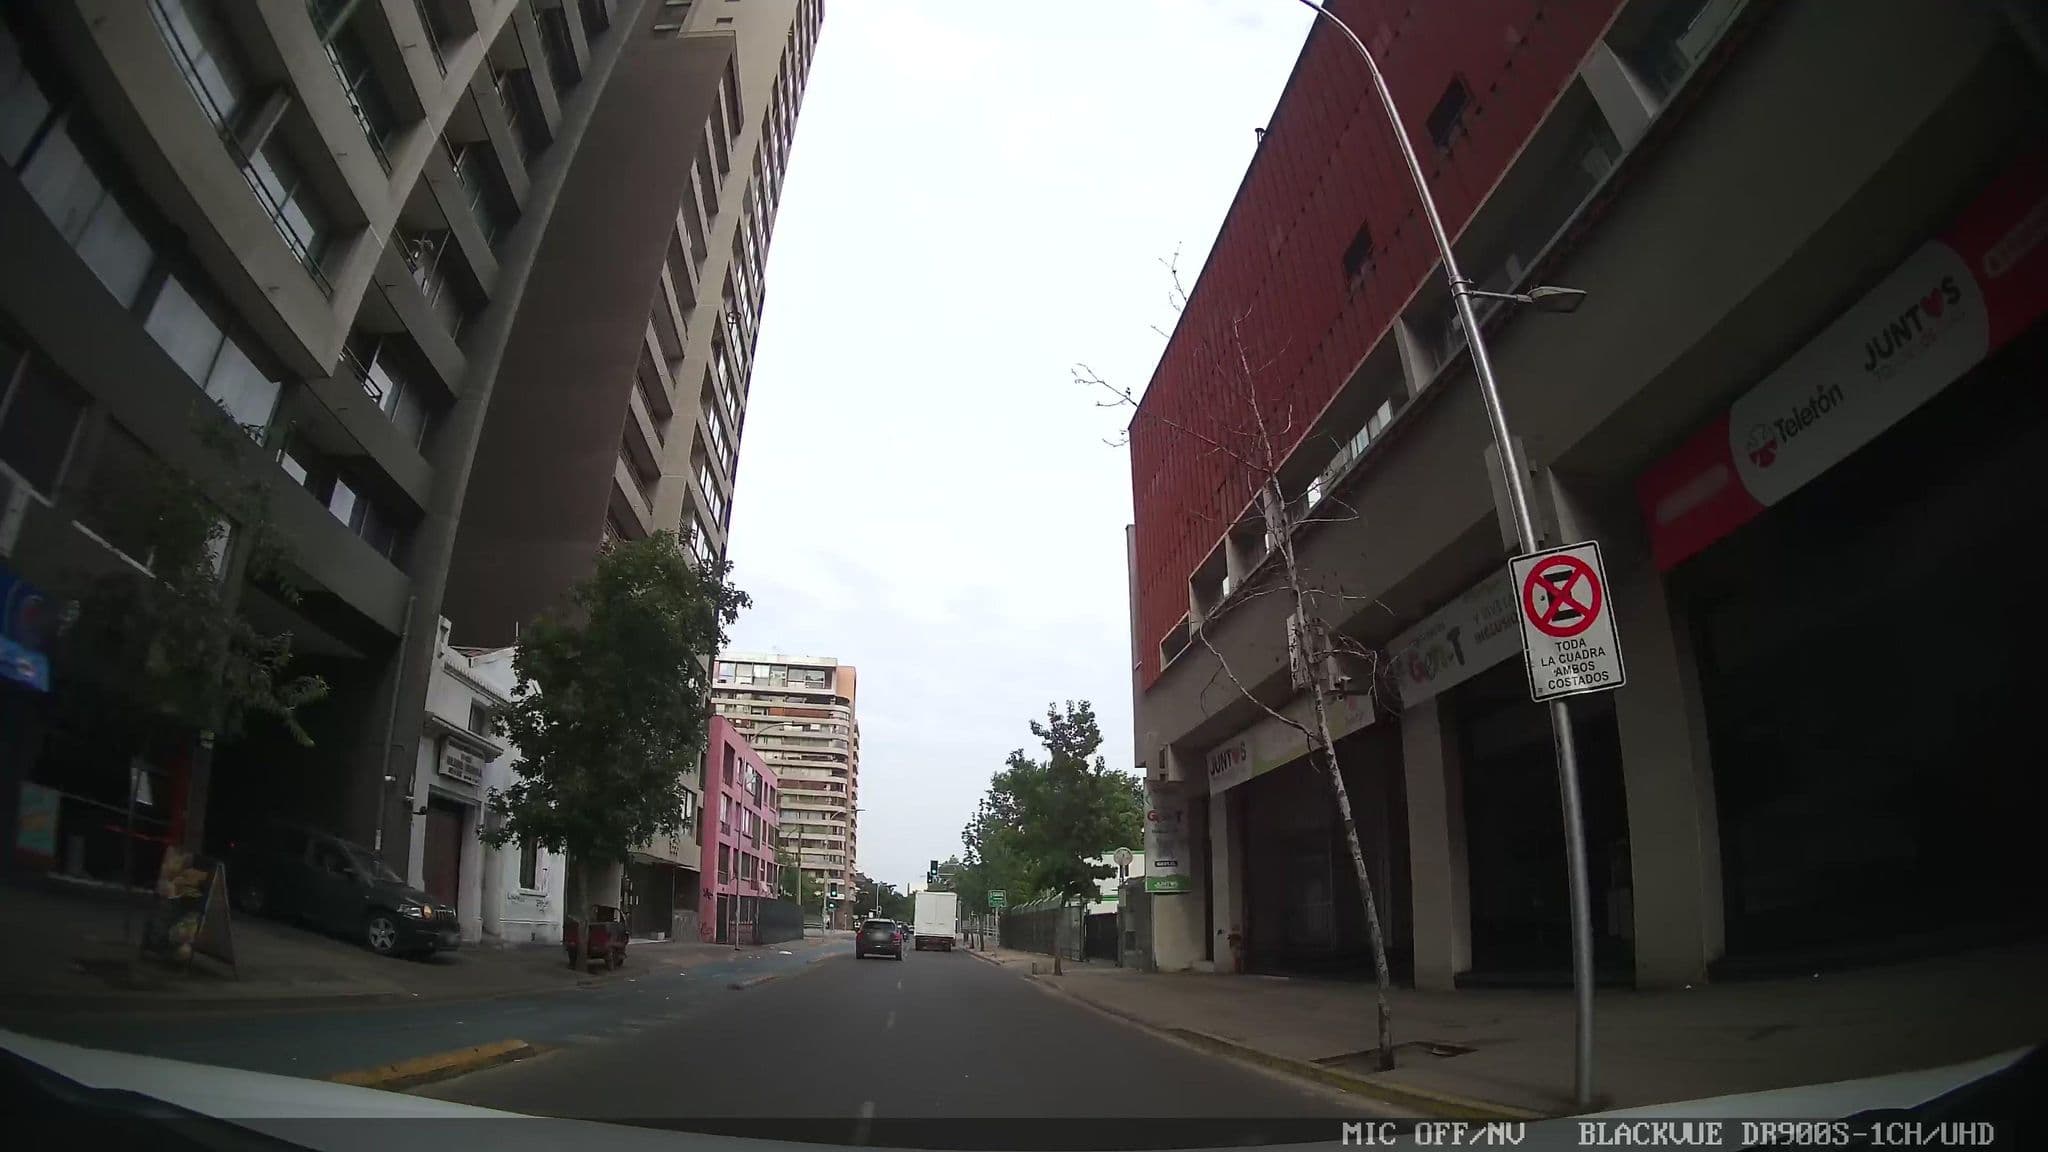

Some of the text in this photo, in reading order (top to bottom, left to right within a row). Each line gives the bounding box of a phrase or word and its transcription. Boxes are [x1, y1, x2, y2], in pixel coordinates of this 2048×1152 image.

[1555, 638, 1587, 652] TODA
[1541, 647, 1606, 667] LA CUADRA
[1555, 661, 1596, 677] AMBOS
[1548, 671, 1609, 690] COSTADOS
